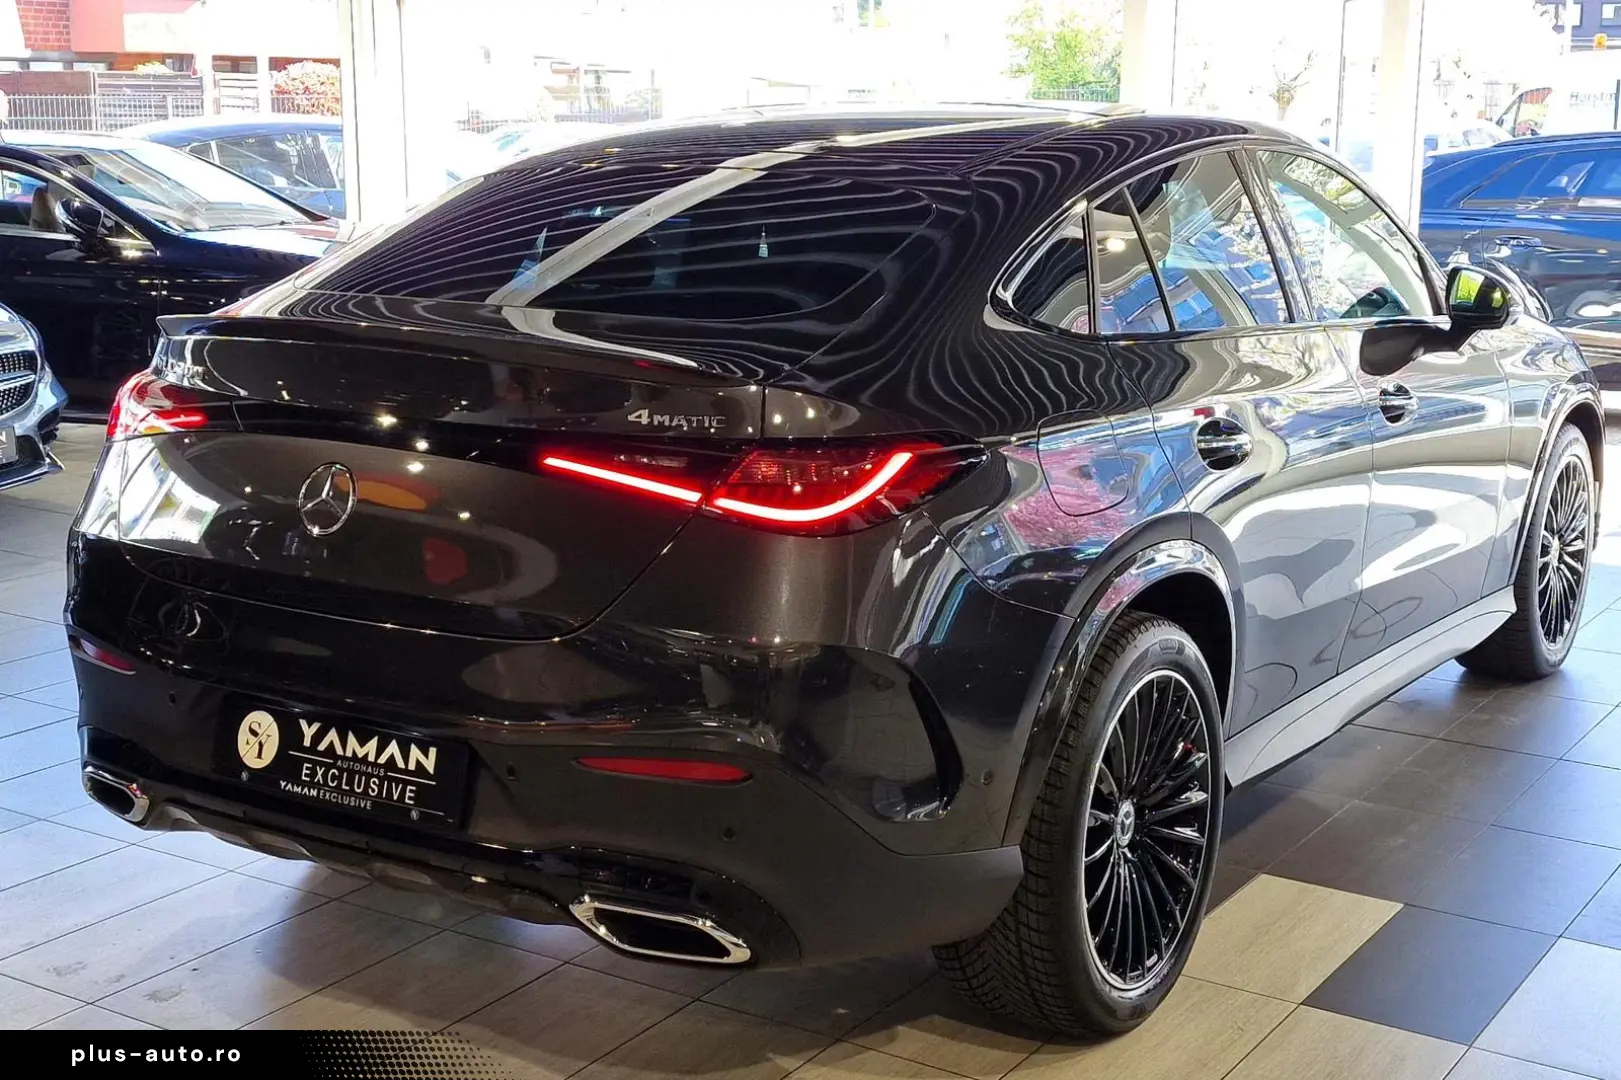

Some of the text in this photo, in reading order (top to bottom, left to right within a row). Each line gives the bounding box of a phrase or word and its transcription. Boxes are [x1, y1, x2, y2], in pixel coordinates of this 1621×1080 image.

[627, 408, 727, 428] 4MATIC
[298, 718, 437, 775] YAMAN
[336, 760, 385, 776] AUTOHAUS
[280, 780, 373, 811] YAMAN EXCLUSIVE
[301, 763, 417, 805] EXCLUSIVE
